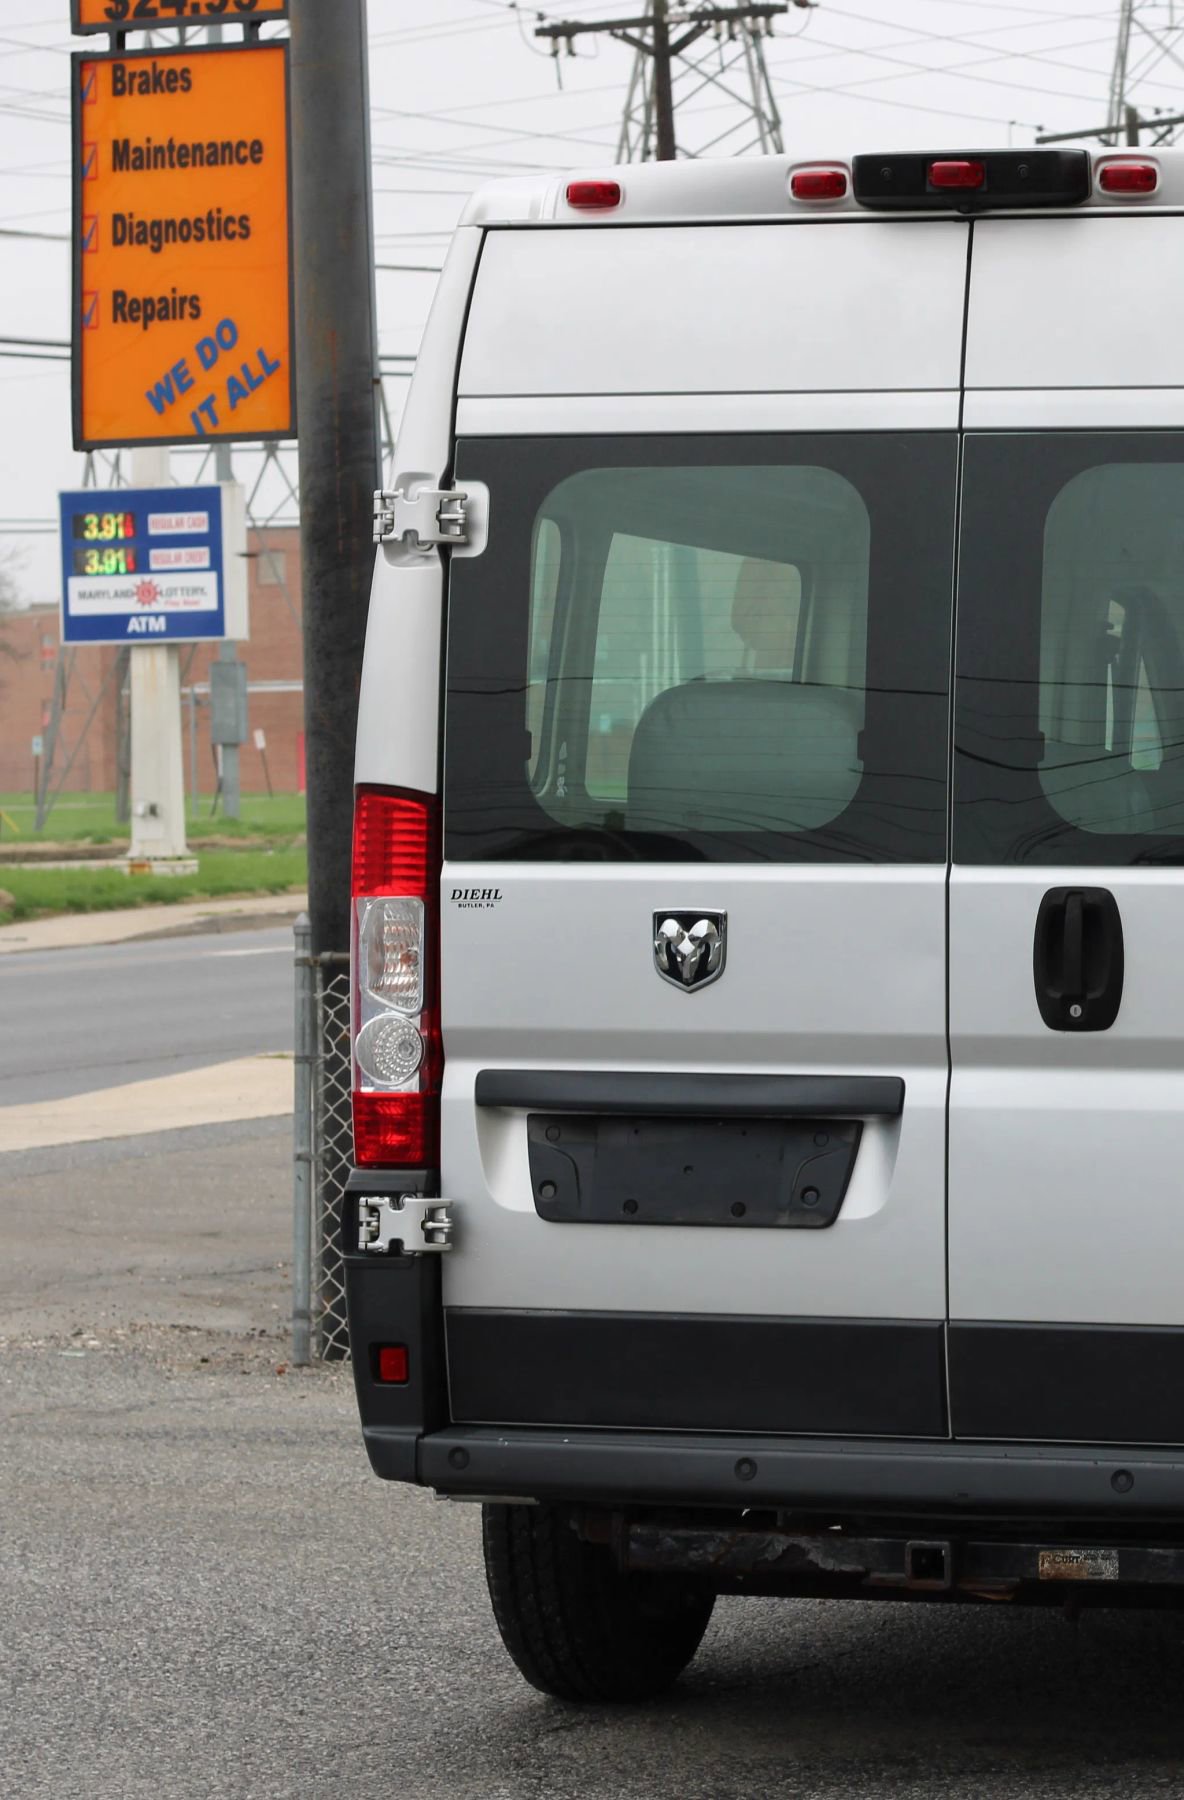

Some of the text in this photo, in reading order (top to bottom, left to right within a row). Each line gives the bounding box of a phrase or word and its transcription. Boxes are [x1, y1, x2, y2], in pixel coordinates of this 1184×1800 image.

[112, 61, 192, 97] Brakes
[112, 137, 264, 172] Maintenance
[112, 208, 251, 253] Diagnostics
[112, 287, 202, 331] Repairs
[145, 317, 239, 416] WE DO
[190, 348, 281, 435] IT ALL
[78, 588, 134, 600] MARYLAND
[127, 615, 166, 633] ATM
[451, 888, 503, 900] DIEHL
